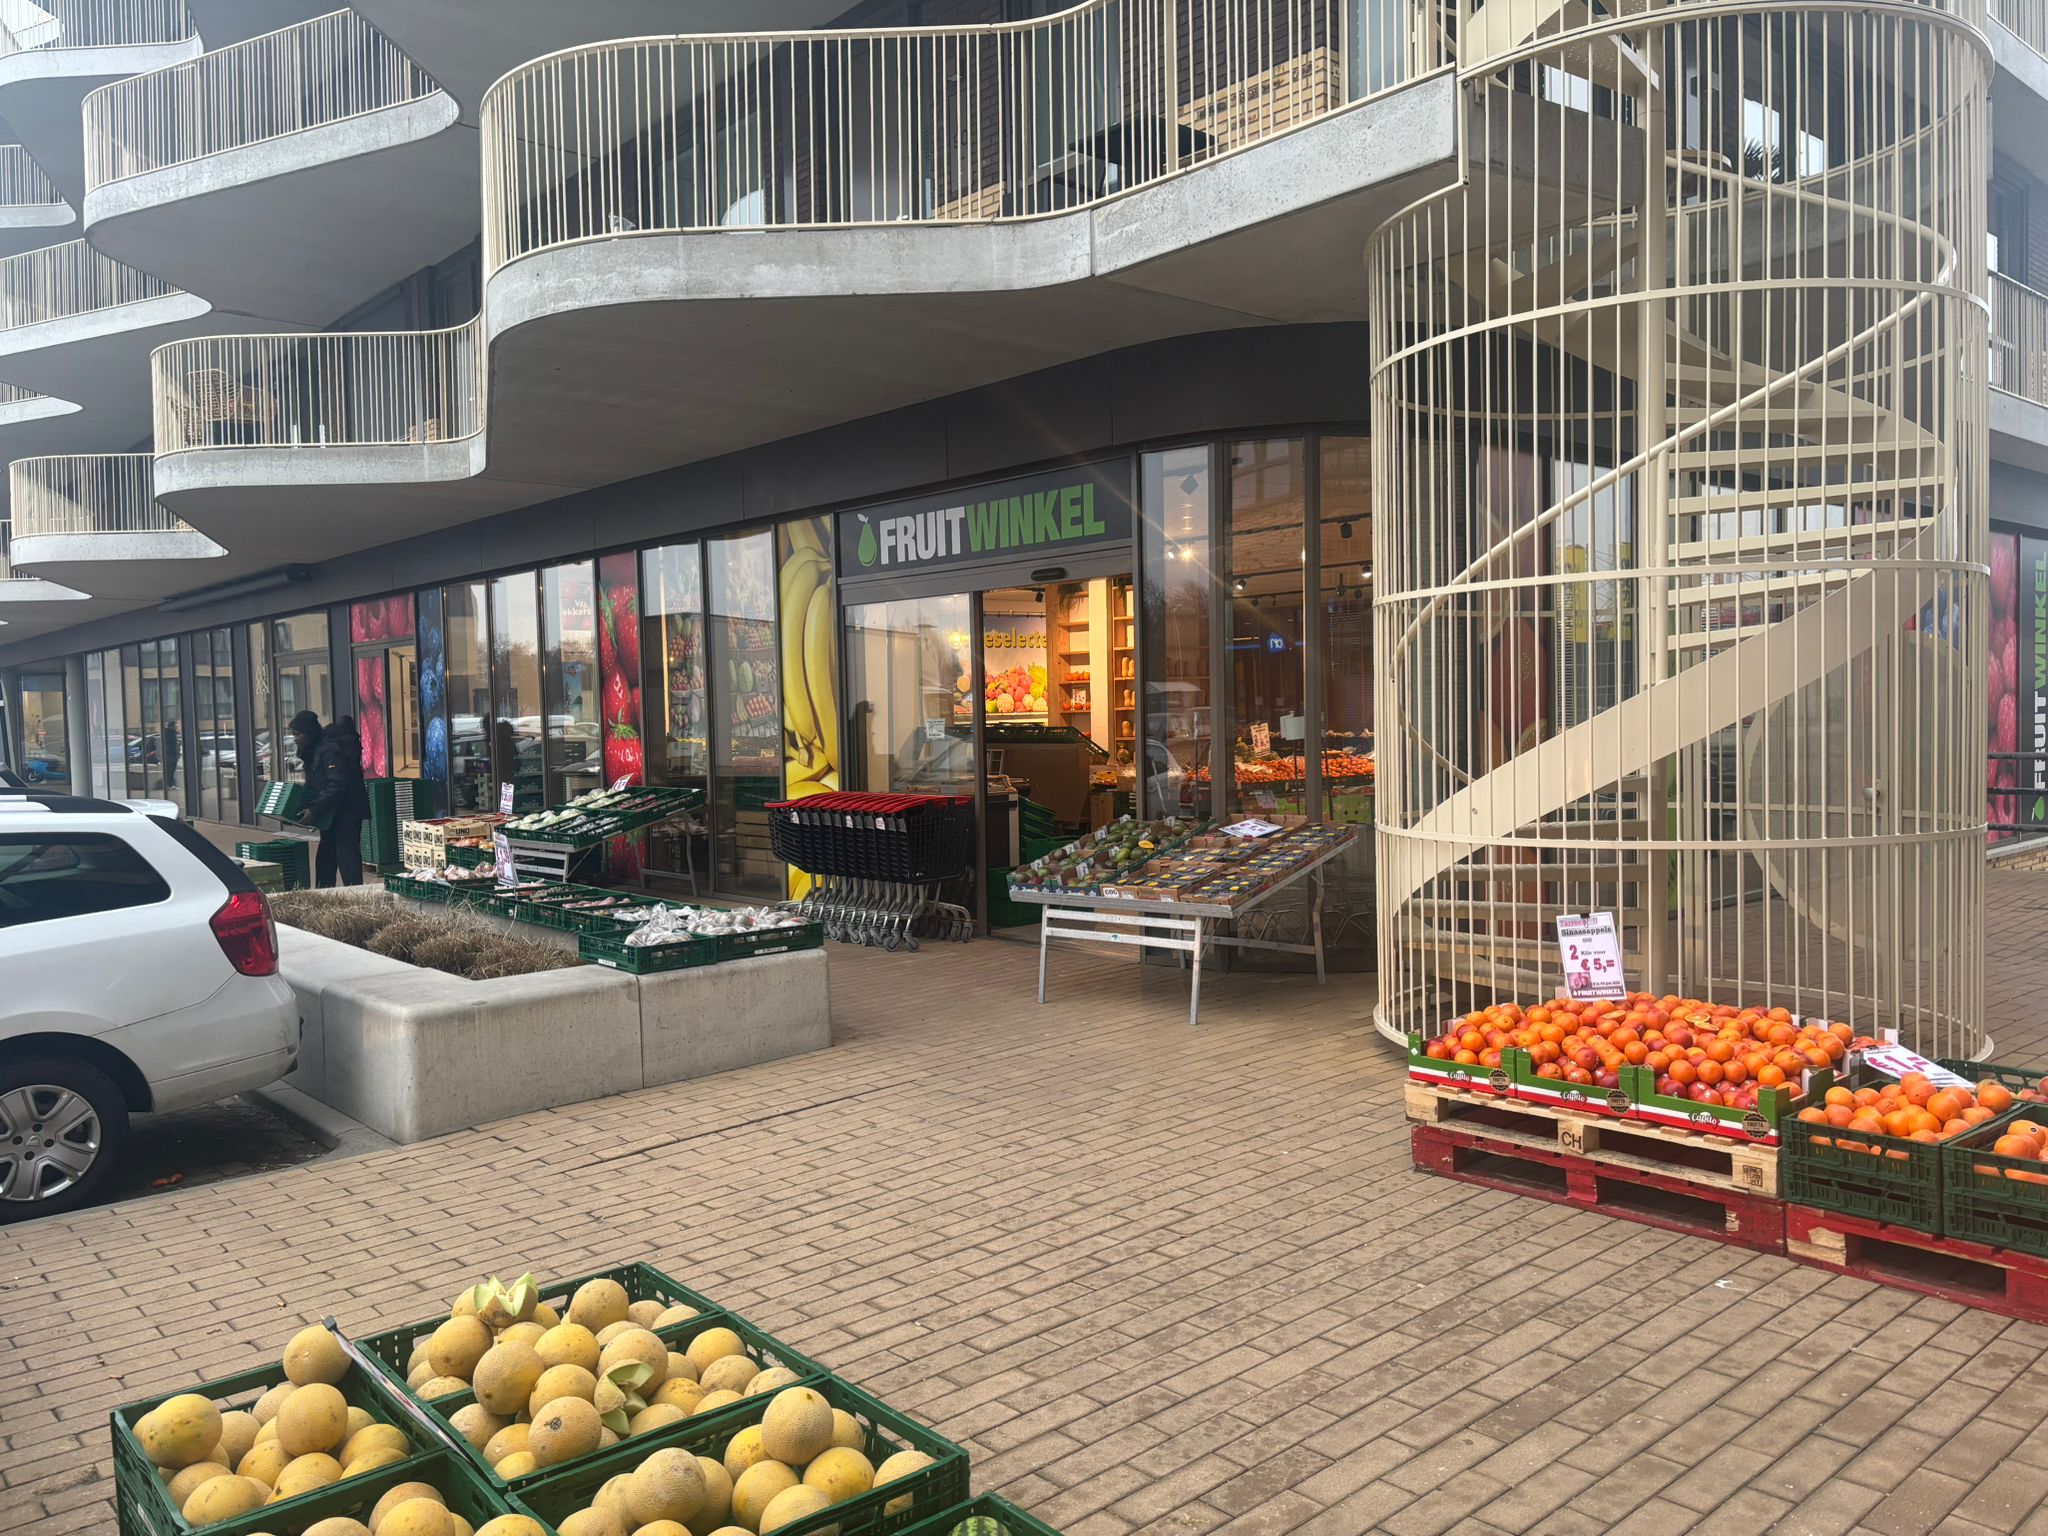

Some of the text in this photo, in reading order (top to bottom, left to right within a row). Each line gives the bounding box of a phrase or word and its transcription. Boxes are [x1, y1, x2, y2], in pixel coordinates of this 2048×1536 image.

[879, 483, 1105, 565] FRUITWINKEL
[2034, 552, 2047, 790] FRUITWINKEL
[1561, 926, 1612, 936] Sinaasappels
[1570, 945, 1579, 960] 2
[1581, 959, 1590, 971] €
[1561, 1131, 1582, 1150] CH
